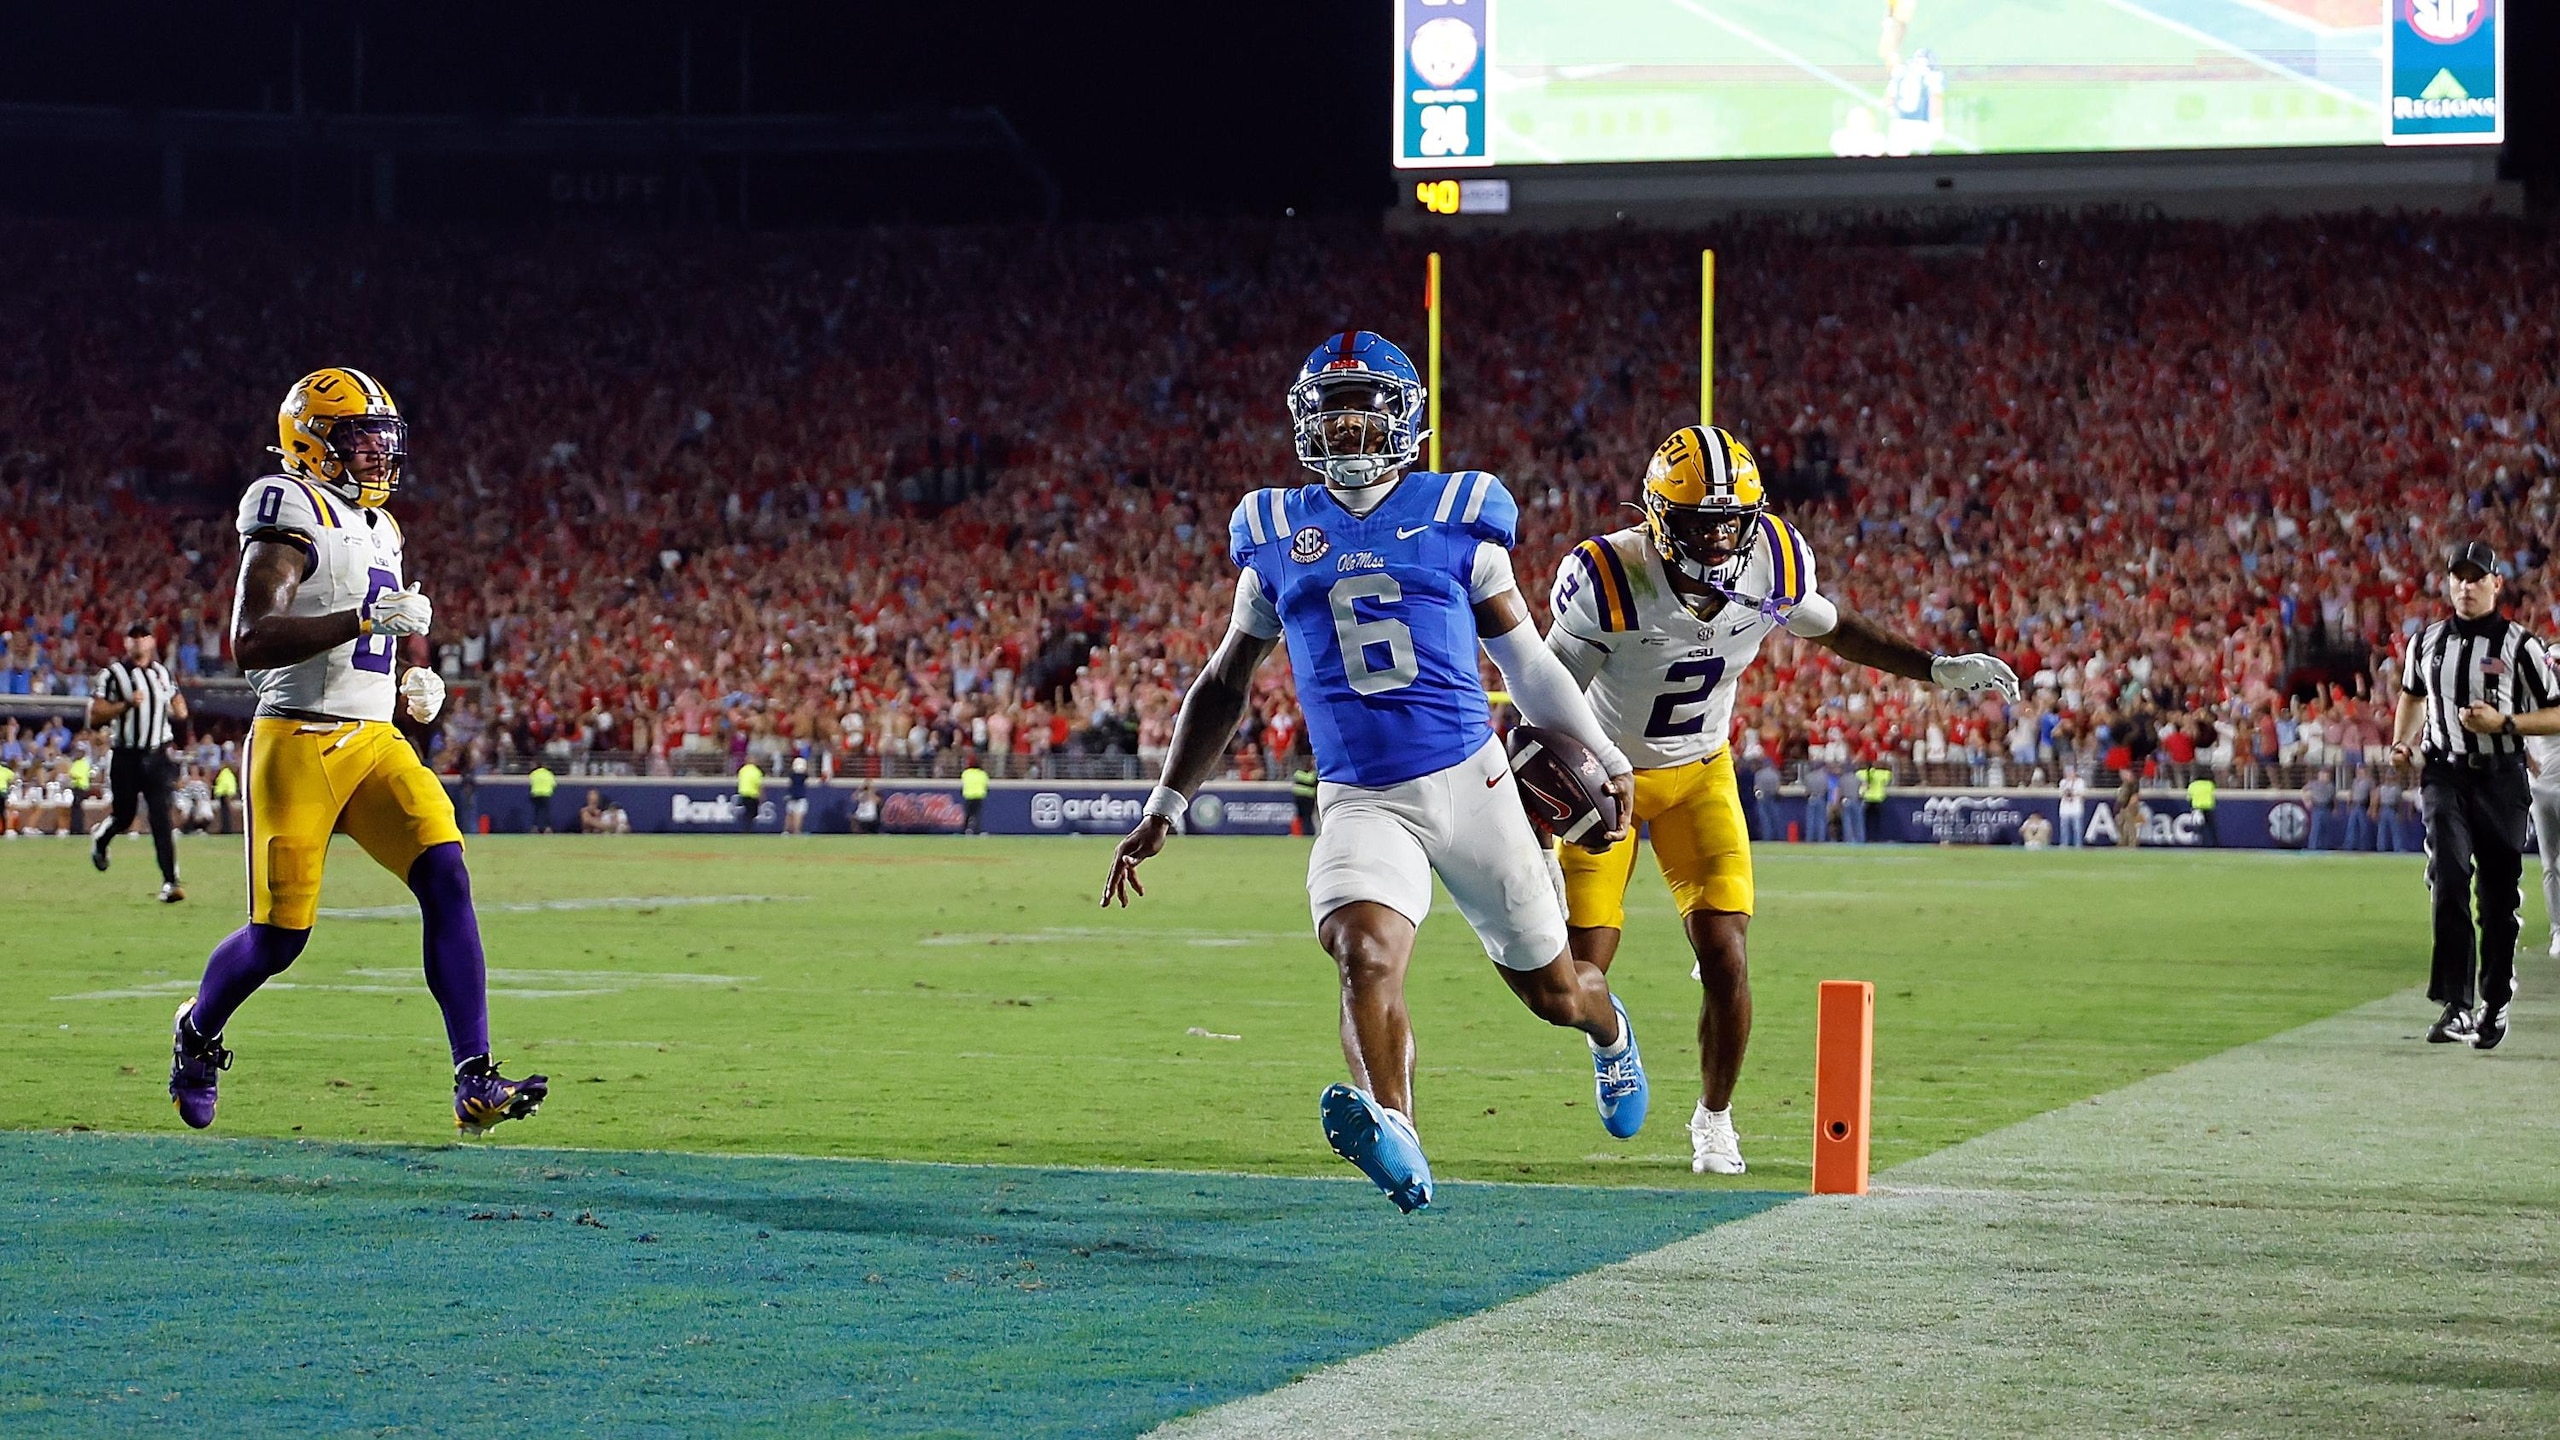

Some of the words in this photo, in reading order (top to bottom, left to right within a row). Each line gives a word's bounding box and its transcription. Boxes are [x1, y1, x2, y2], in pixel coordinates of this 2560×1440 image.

[1416, 180, 1459, 213] 40
[1295, 528, 1322, 554] SEC
[1336, 553, 1357, 573] Ole
[1355, 551, 1386, 570] Miss
[1555, 573, 1580, 615] 2
[1328, 572, 1420, 696] 6
[1687, 647, 1714, 658] LSU
[1644, 656, 1726, 738] 2
[1062, 794, 1142, 820] arden
[1970, 810, 2021, 824] RIVER
